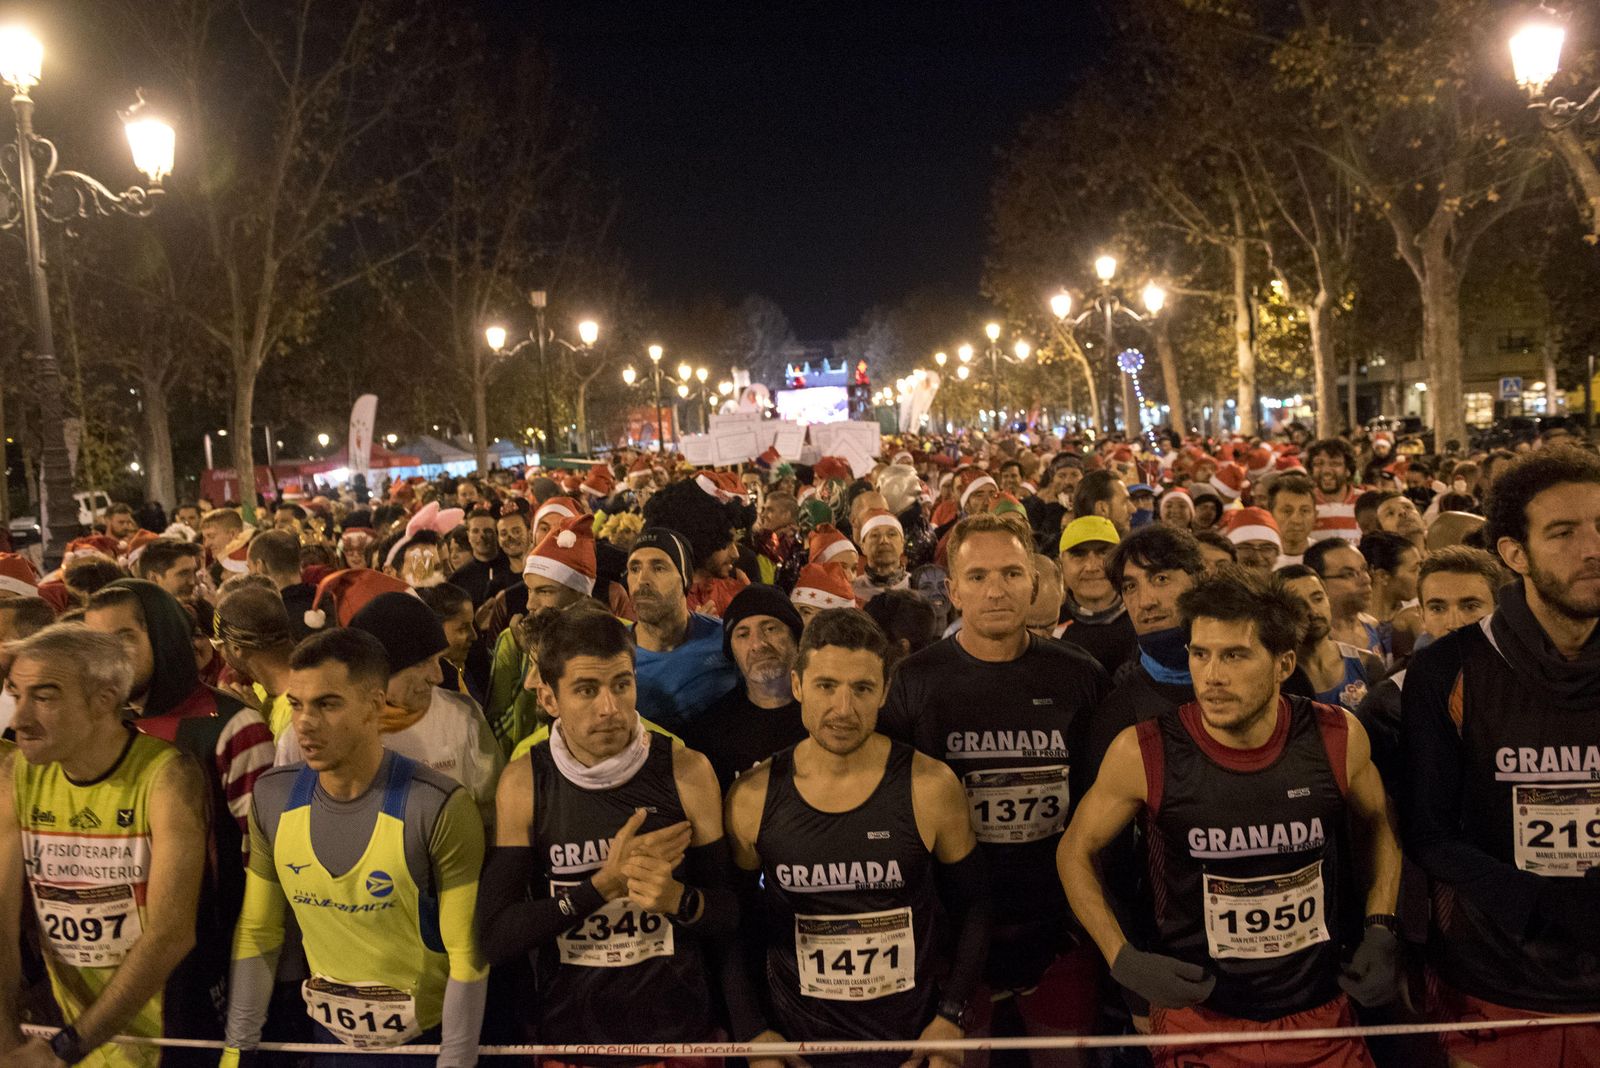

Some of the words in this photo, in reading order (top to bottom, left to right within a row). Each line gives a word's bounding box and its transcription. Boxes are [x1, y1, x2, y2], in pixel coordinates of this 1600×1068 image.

[946, 729, 1066, 752] GRANADA
[974, 795, 1060, 822] 1373
[1188, 817, 1324, 851] GRANADA
[46, 843, 133, 860] FISIOTERAPIA
[46, 864, 143, 880] E.MONASTERIO
[776, 860, 902, 886] GRANADA
[292, 895, 397, 913] SILVERBACK
[1218, 896, 1316, 935] 1950
[45, 912, 128, 942] 2097
[566, 911, 661, 940] 2346
[808, 944, 900, 976] 1471
[316, 1002, 407, 1033] 1614
[656, 1043, 677, 1055] de
